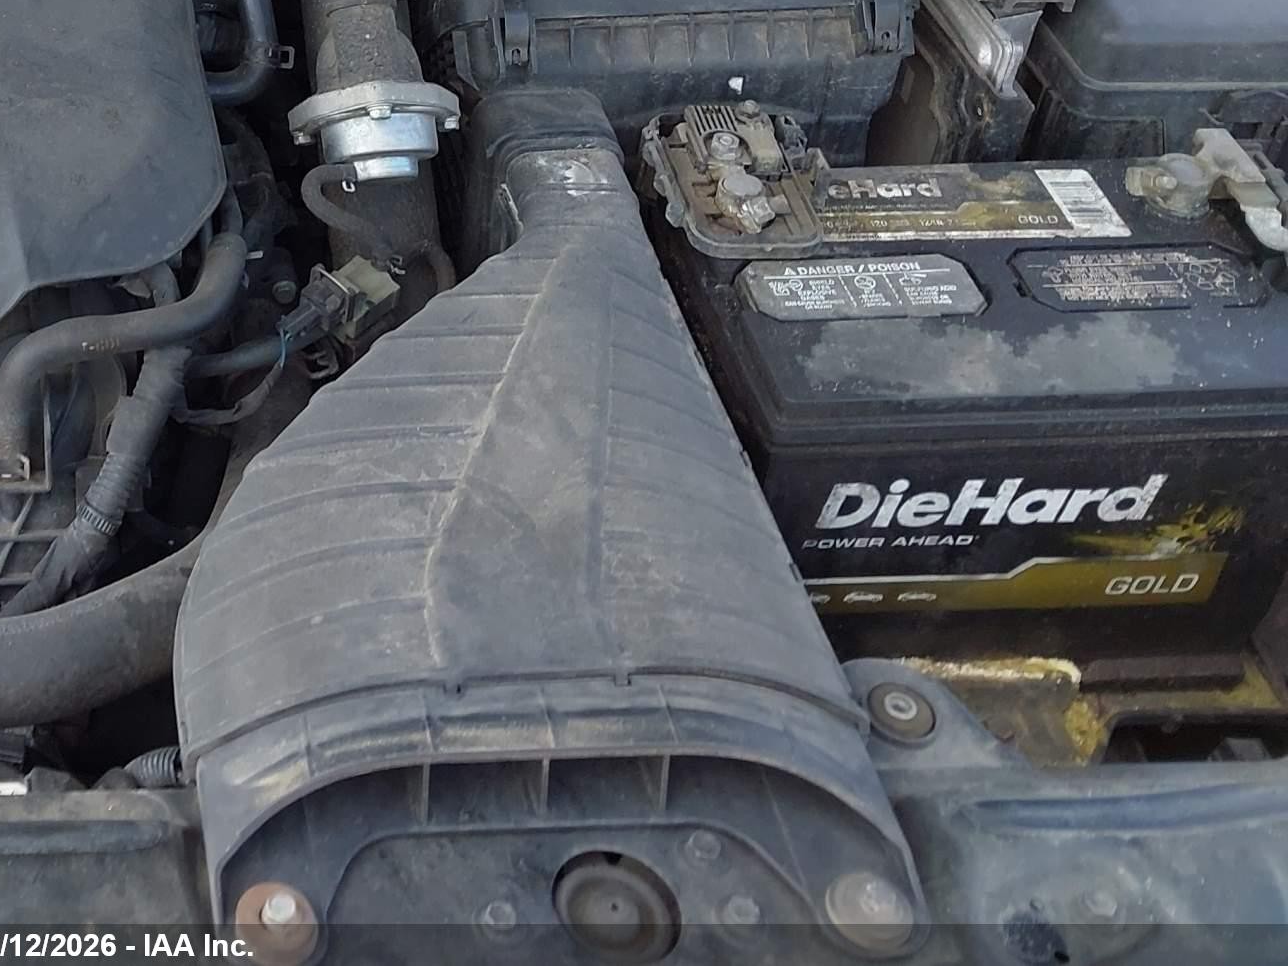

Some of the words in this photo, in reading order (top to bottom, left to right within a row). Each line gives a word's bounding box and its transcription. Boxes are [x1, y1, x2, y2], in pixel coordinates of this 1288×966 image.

[827, 178, 943, 199] eHard
[1018, 215, 1058, 225] GOLD
[797, 264, 855, 275] DANGER
[868, 262, 920, 272] POISON
[815, 474, 1168, 529] DieHard
[802, 535, 883, 550] POWER
[891, 535, 975, 547] AHEAD
[1105, 573, 1200, 596] GOLD
